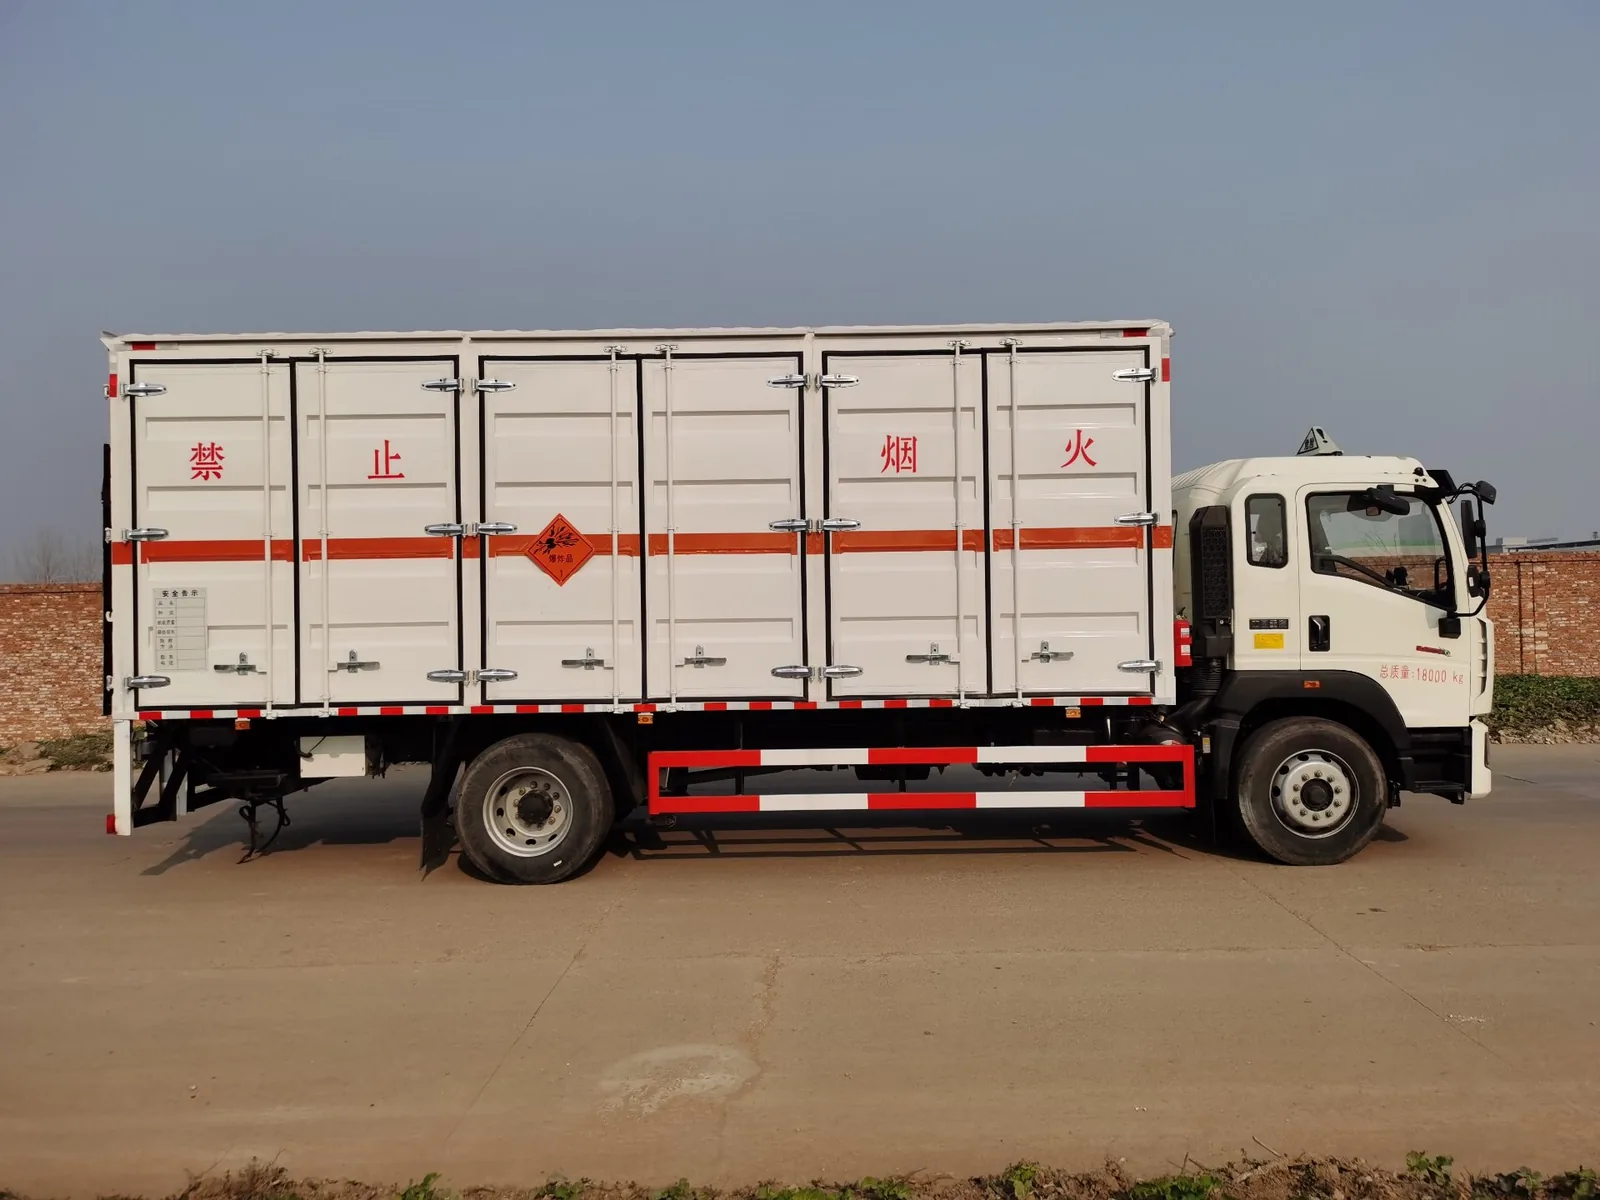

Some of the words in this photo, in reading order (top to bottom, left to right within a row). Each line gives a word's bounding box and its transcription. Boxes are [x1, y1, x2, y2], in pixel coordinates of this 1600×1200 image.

[189, 441, 226, 481] 禁
[367, 439, 405, 480] 止
[880, 434, 918, 474] 烟
[1060, 428, 1098, 469] 火
[549, 554, 573, 563] 爆炸品
